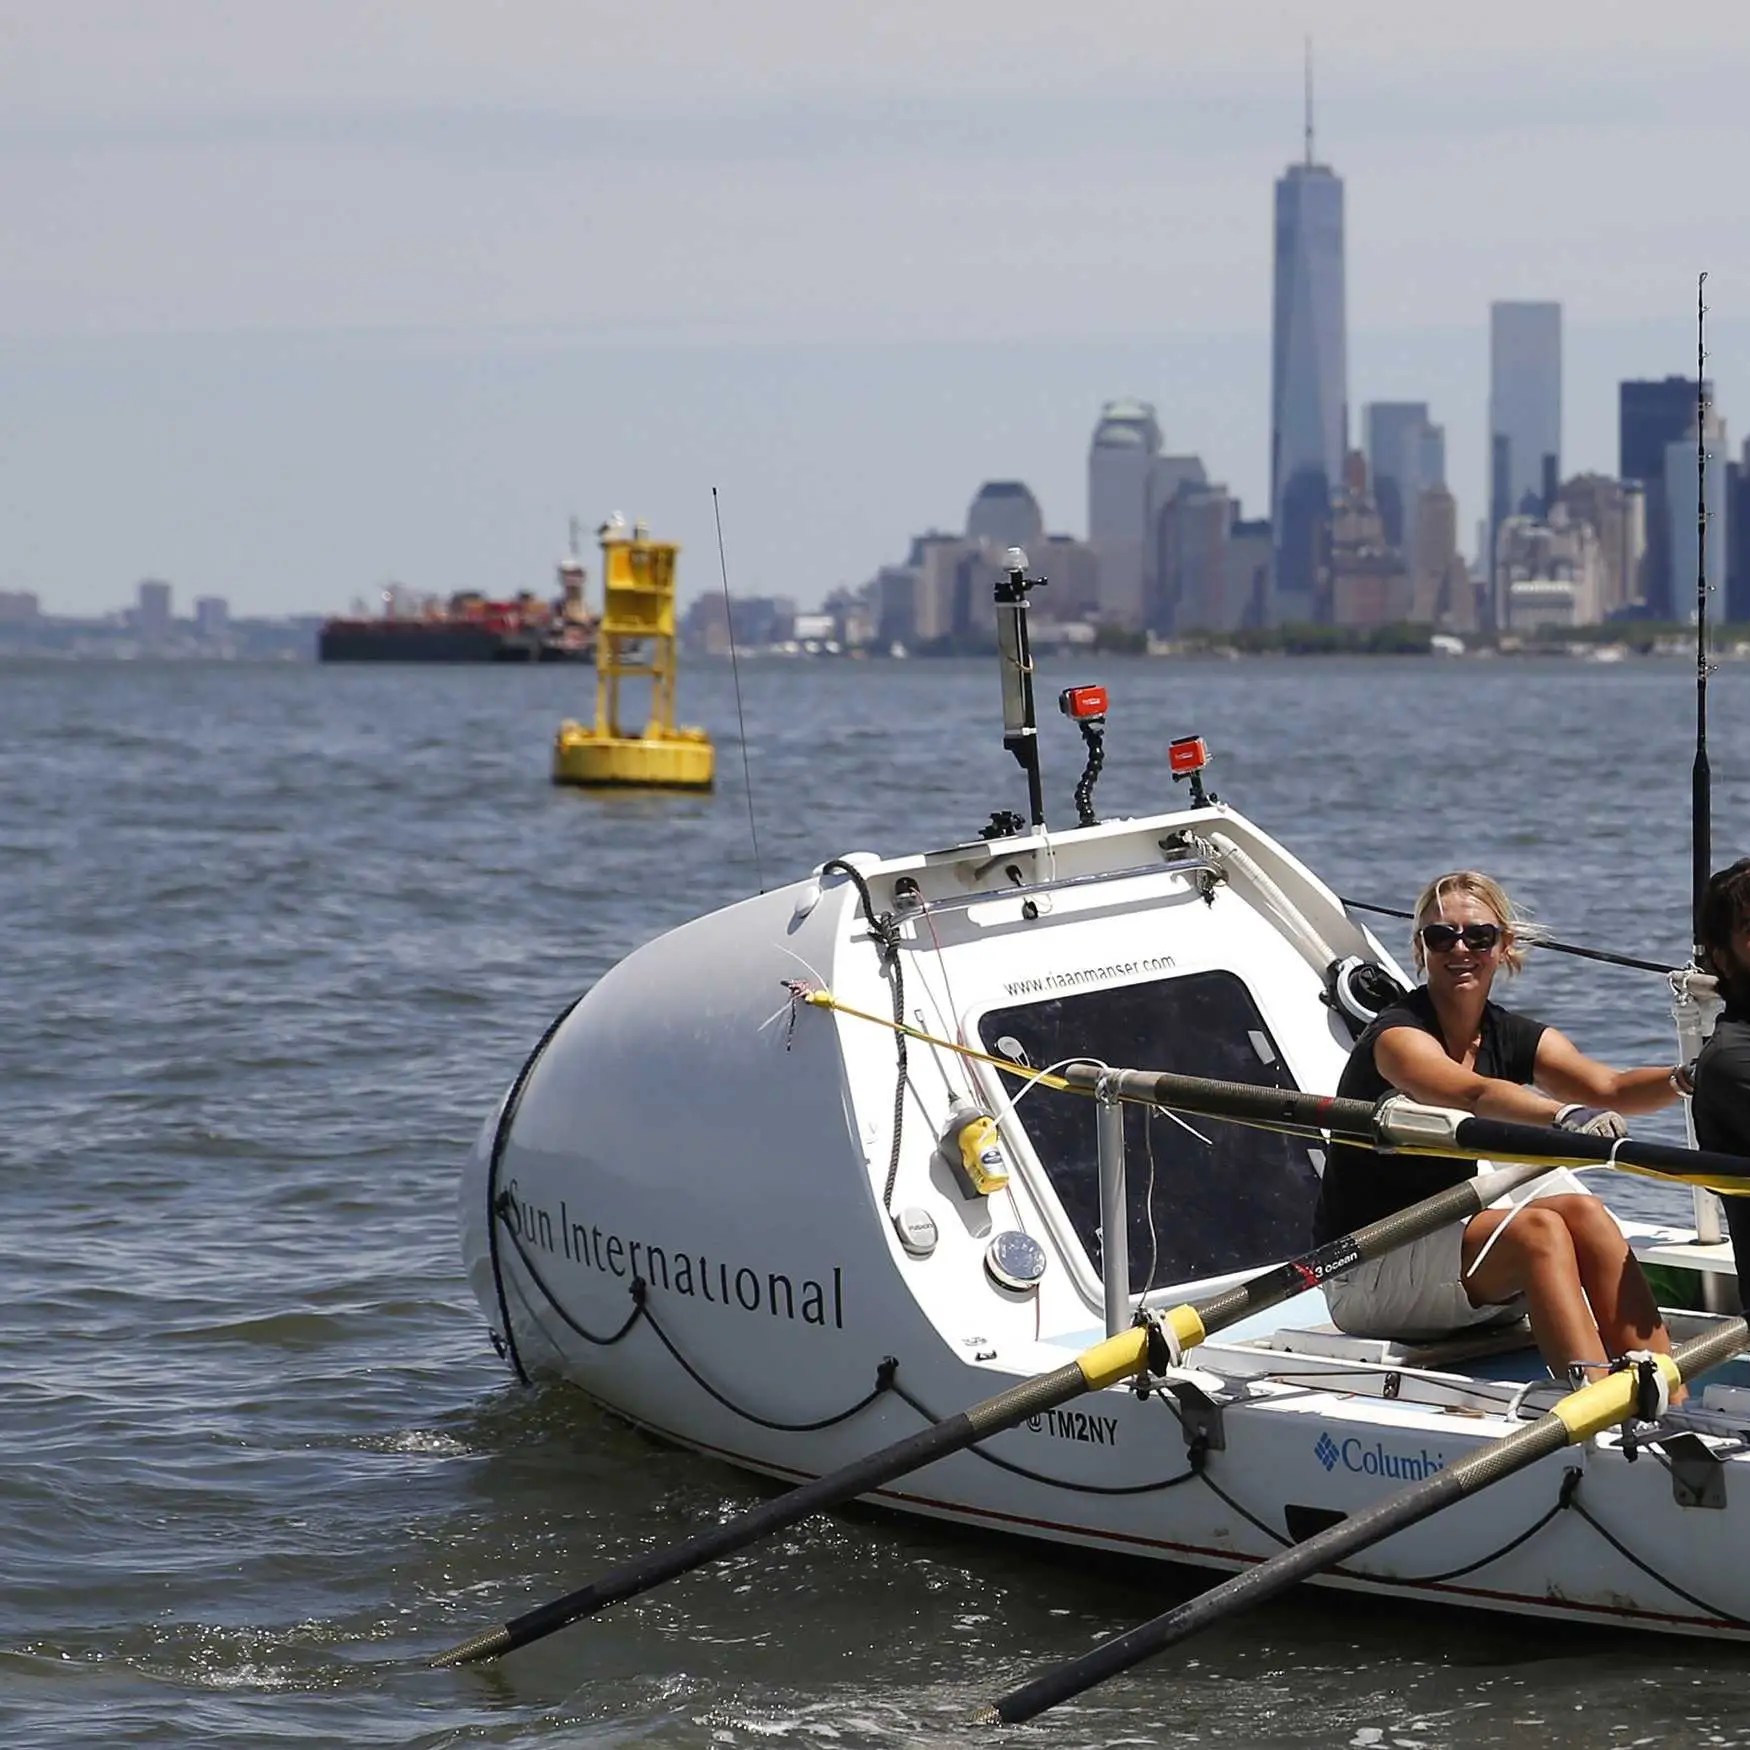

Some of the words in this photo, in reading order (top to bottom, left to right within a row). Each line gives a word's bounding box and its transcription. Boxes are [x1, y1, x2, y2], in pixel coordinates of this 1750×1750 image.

[1004, 955, 1176, 996] www.riaanmanser.com
[508, 1179, 554, 1252] Sun
[560, 1201, 843, 1329] International
[1324, 1251, 1358, 1273] ocean
[1341, 1437, 1445, 1481] Columbi
